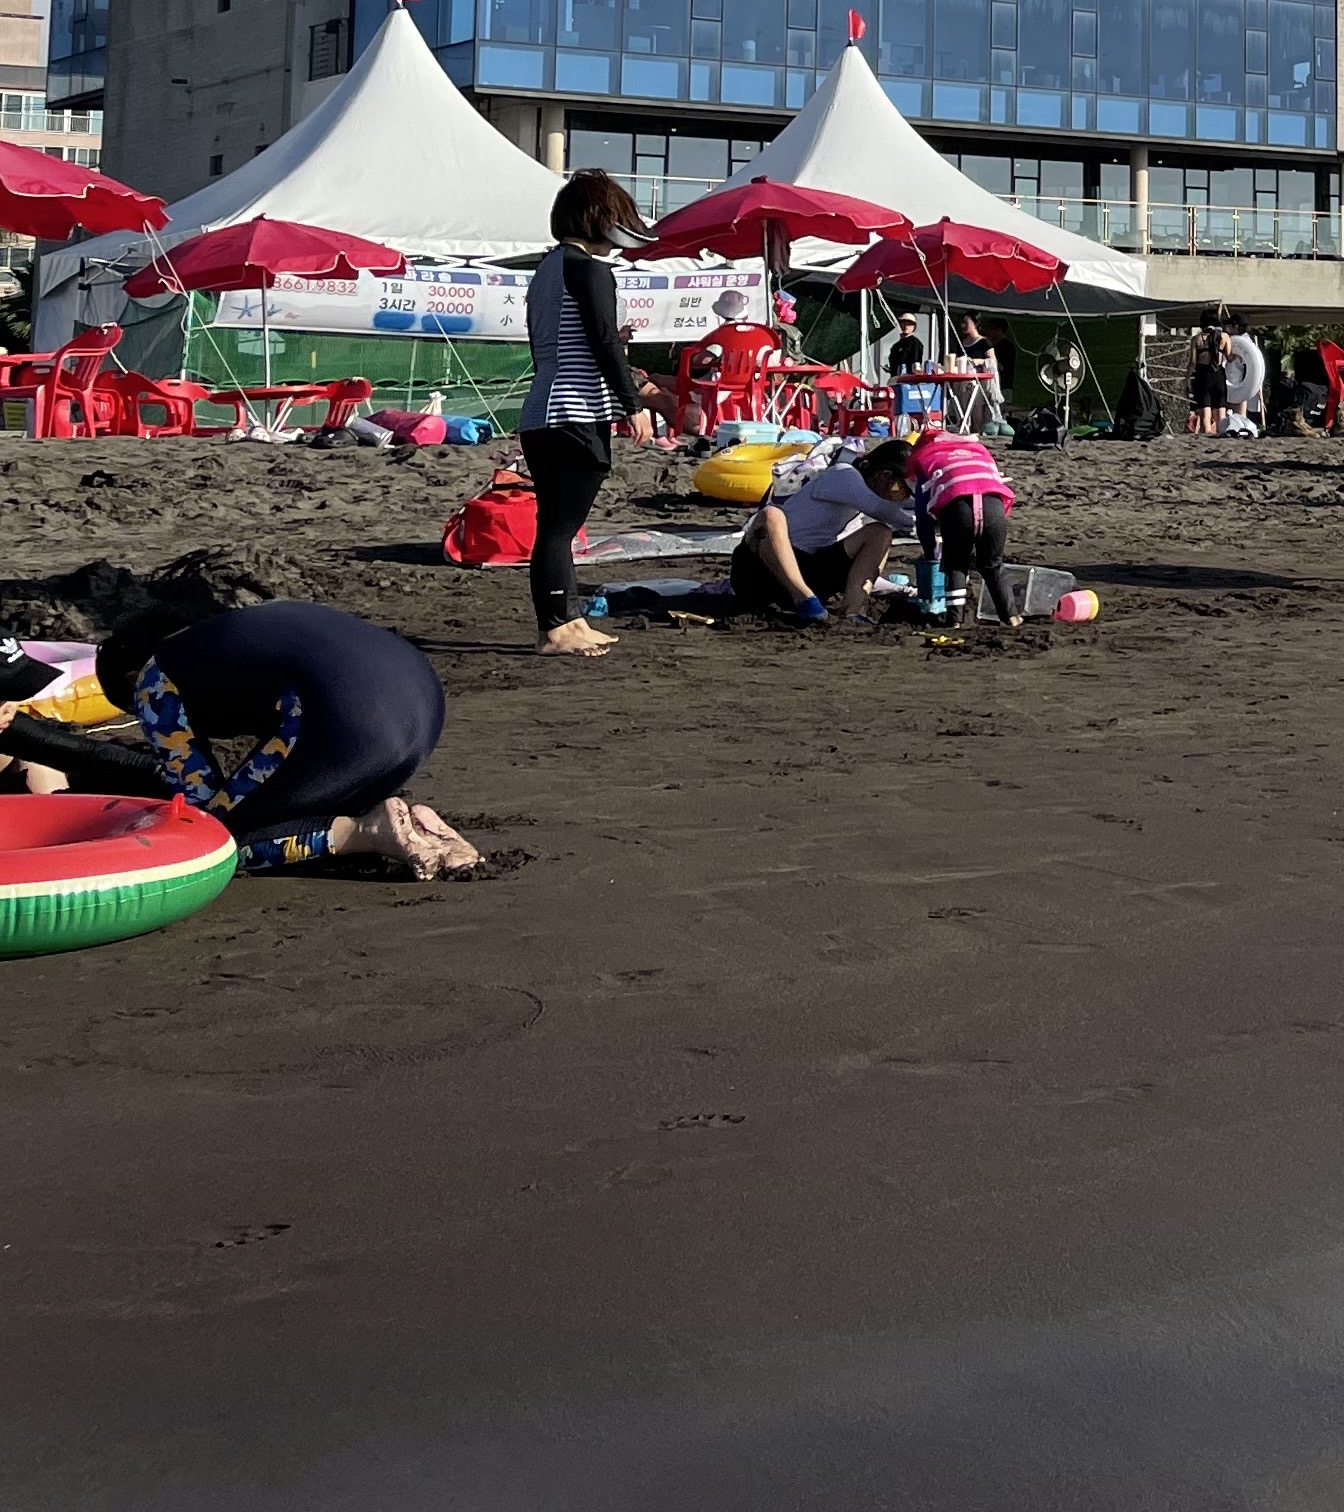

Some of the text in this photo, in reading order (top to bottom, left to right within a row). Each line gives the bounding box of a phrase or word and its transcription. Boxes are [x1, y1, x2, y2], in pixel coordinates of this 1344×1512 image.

[382, 282, 475, 298] 1일 30,000
[379, 297, 474, 315] 3시간 20,000
[679, 296, 702, 308] 일반
